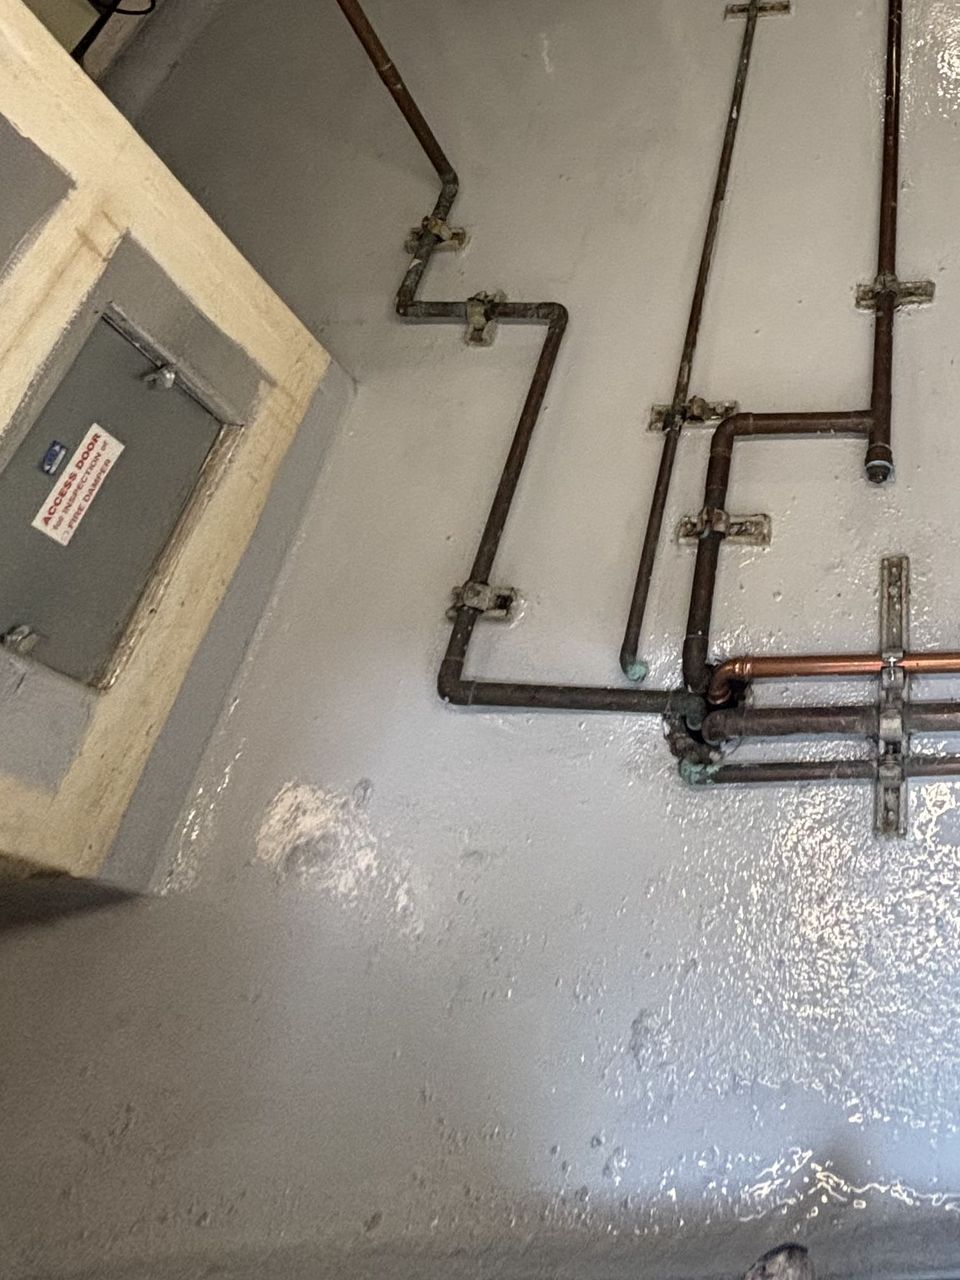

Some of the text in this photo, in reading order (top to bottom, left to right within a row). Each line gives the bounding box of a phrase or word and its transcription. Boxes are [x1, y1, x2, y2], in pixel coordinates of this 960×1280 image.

[42, 433, 101, 526] ACCESS DOOR
[63, 452, 101, 514] INSPECTION
[68, 459, 111, 530] FIRE DAMPER
